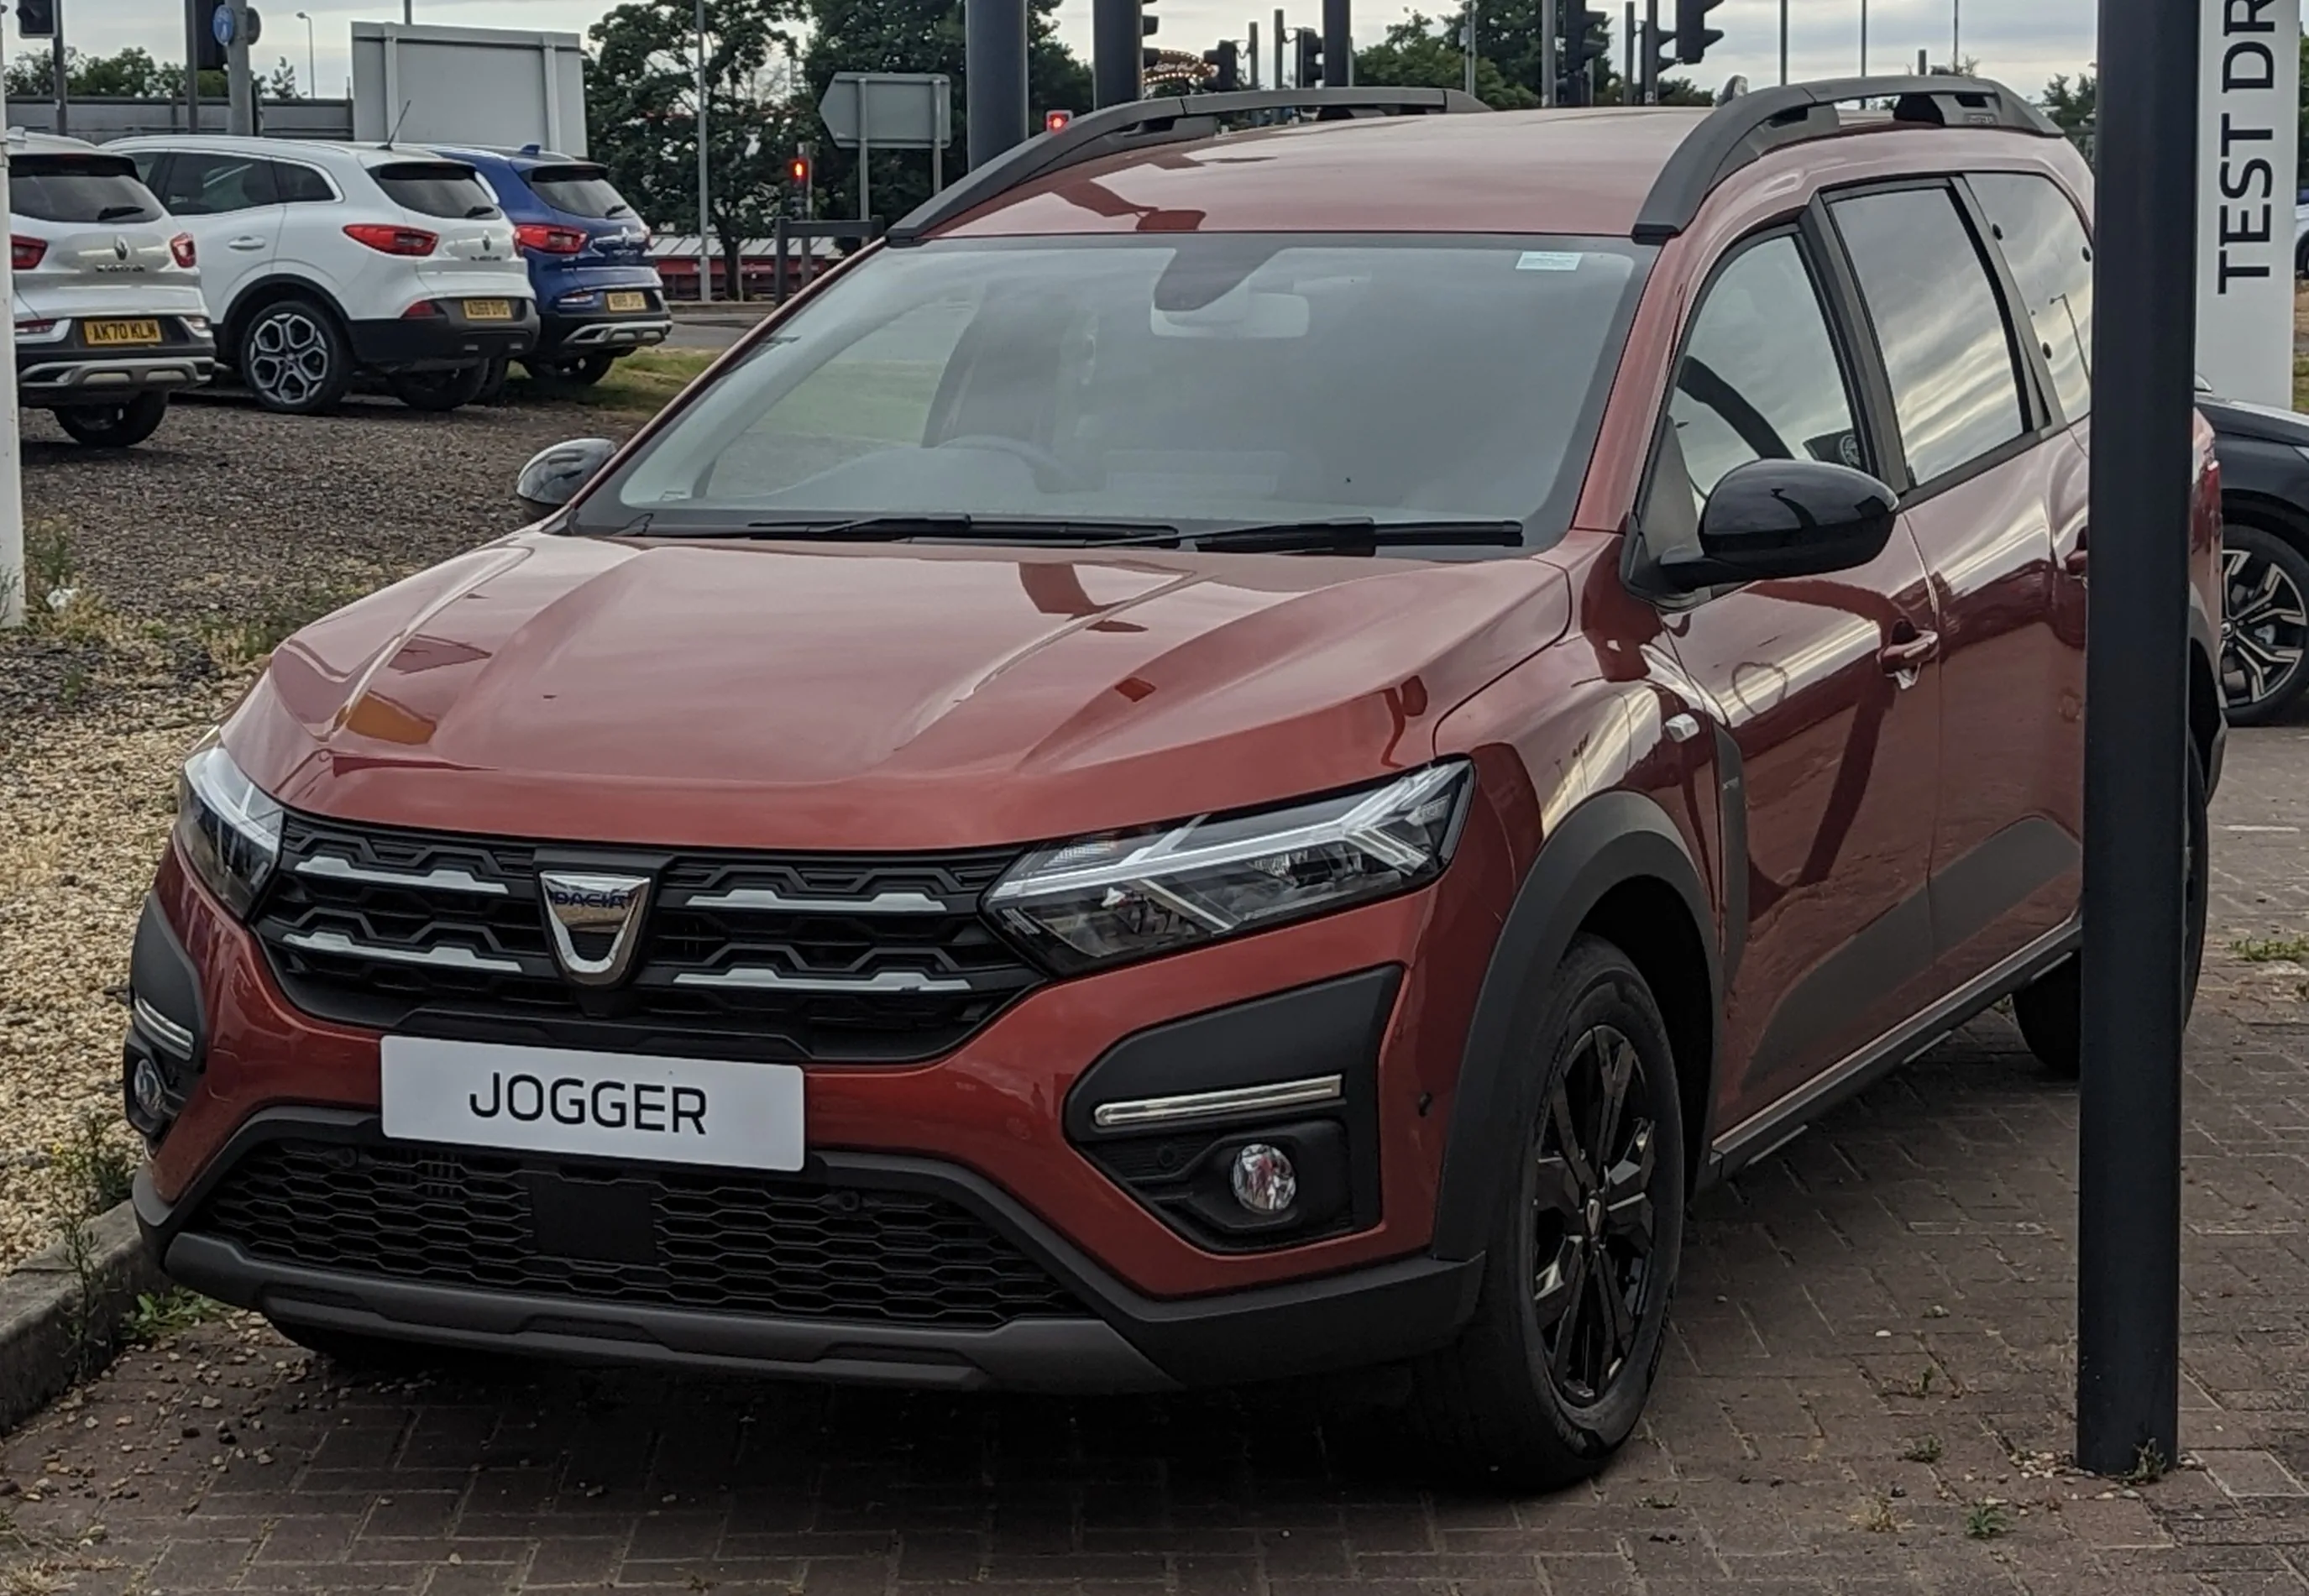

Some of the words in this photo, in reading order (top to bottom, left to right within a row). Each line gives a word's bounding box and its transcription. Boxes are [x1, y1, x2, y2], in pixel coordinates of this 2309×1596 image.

[2221, 0, 2275, 93] DR
[2217, 113, 2274, 295] TEST
[92, 322, 128, 341] AK70
[554, 890, 626, 909] DACIA
[469, 1072, 707, 1135] JOGGER
